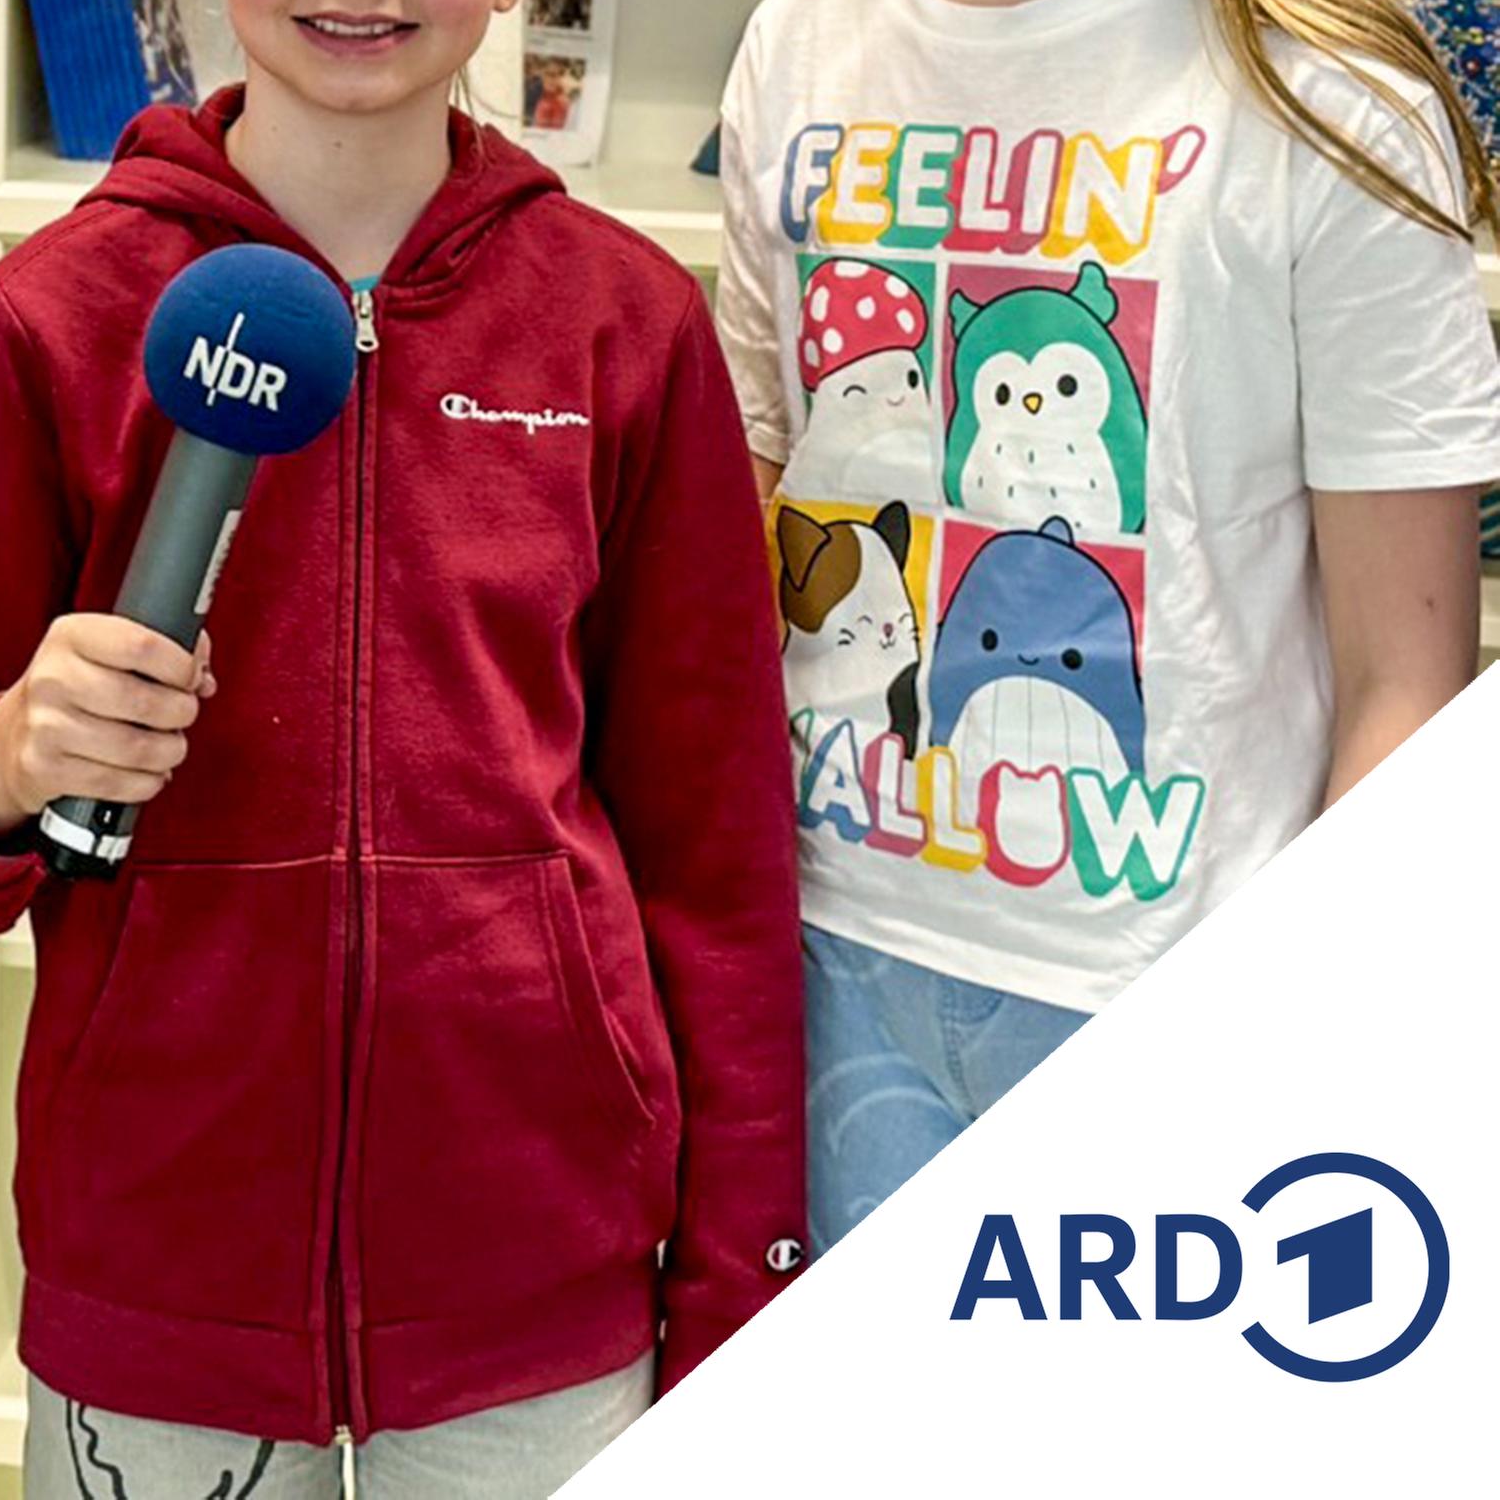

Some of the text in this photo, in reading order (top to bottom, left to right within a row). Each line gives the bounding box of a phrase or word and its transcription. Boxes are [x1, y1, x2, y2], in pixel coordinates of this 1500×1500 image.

[183, 326, 287, 411] NDR
[440, 392, 590, 435] Champion
[790, 707, 1206, 902] ALLOW
